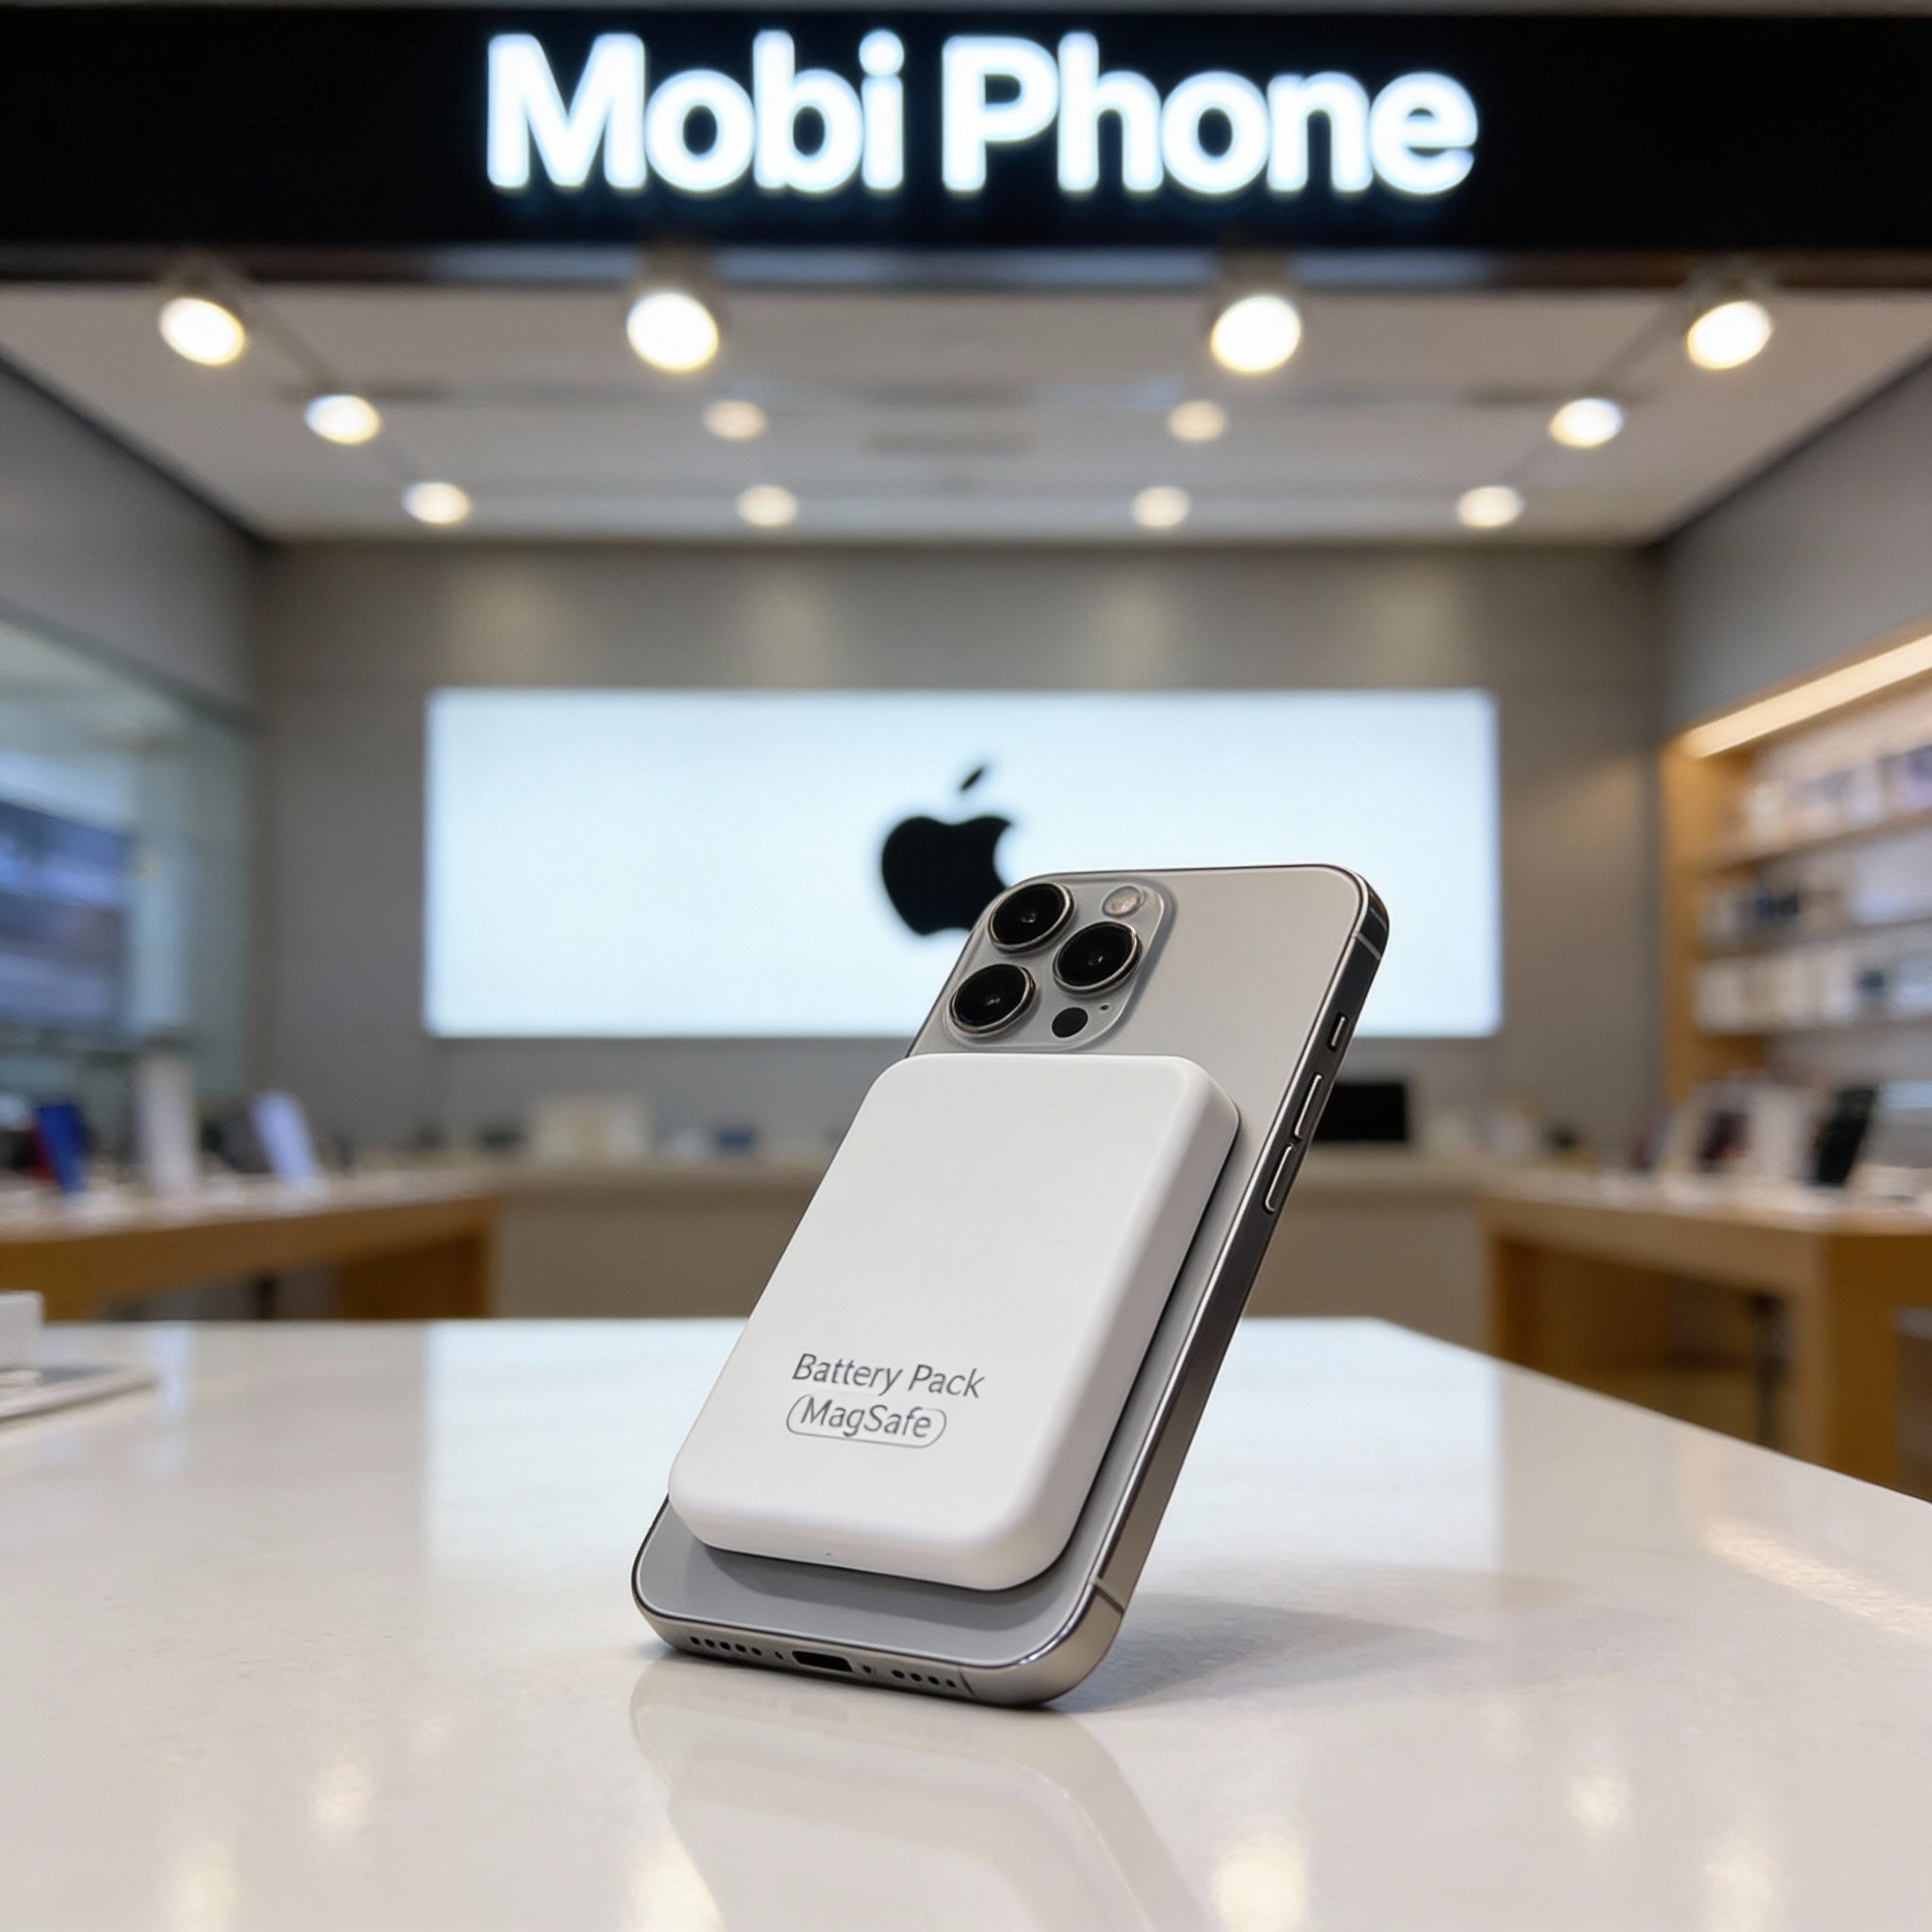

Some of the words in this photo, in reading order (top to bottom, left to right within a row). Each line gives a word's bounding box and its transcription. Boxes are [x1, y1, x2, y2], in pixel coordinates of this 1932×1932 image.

[486, 29, 906, 196] Mobi
[941, 29, 1479, 197] Phone
[791, 1353, 903, 1396] Battery
[908, 1364, 985, 1398] Pack
[800, 1396, 932, 1439] MagSafe
